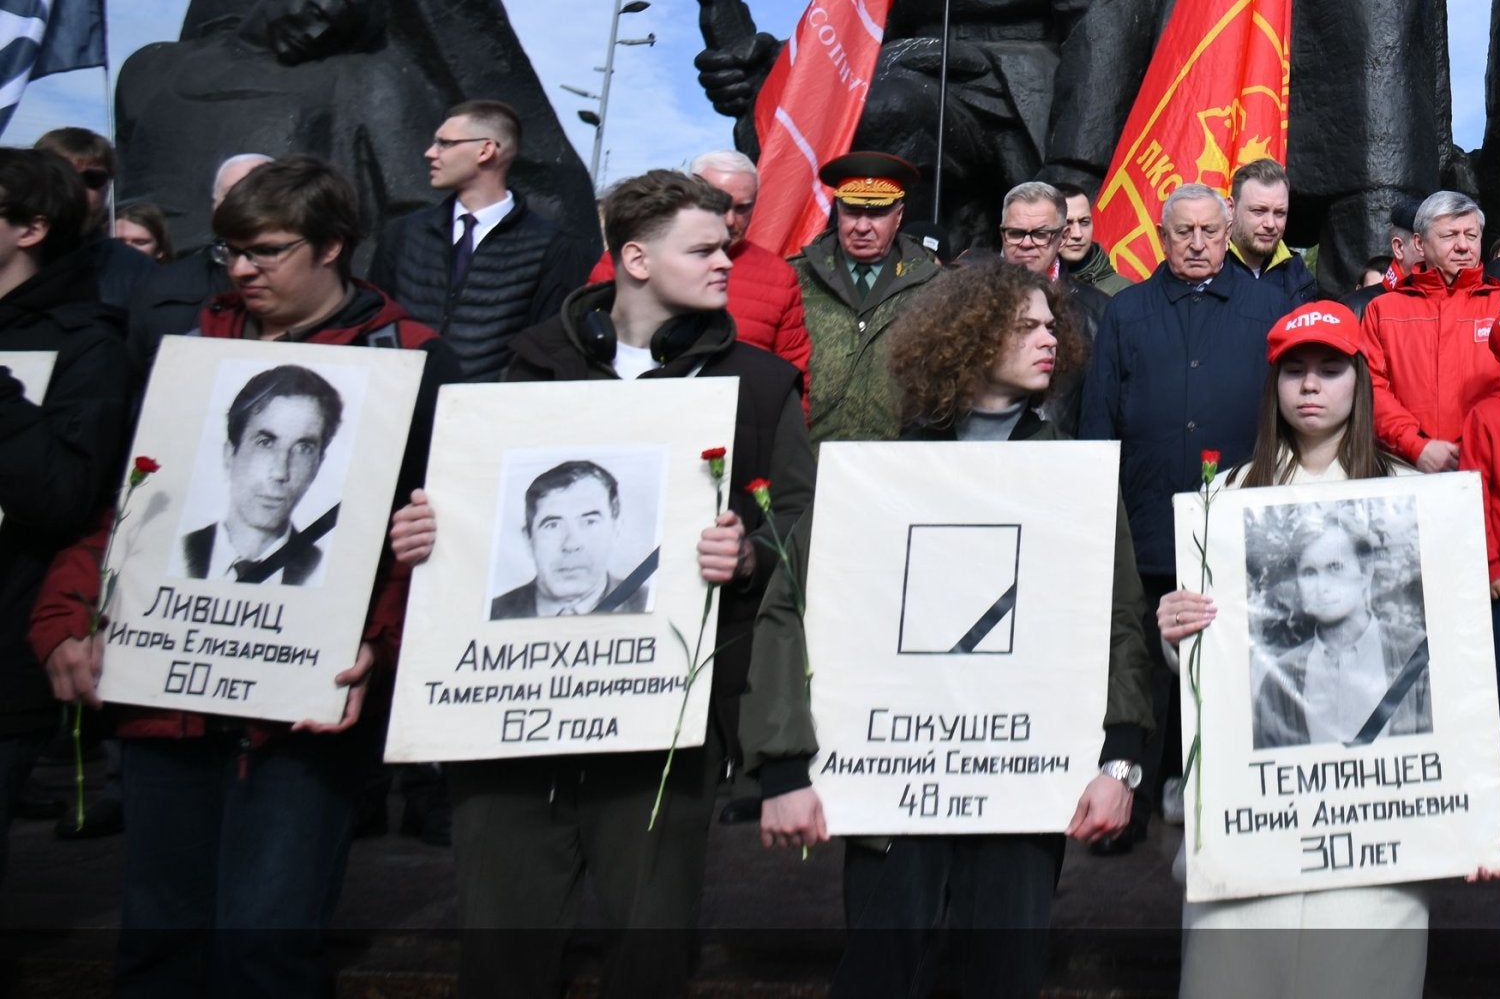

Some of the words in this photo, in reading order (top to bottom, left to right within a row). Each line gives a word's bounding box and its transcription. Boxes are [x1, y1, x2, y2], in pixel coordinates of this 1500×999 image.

[1136, 139, 1184, 201] ЛКС
[1285, 311, 1341, 331] КПРФ
[143, 585, 285, 634] ЛИВШИЦ
[107, 622, 176, 650] ИГОРЬ
[183, 629, 319, 666] ЕЛИЗАРОВИЧ
[455, 637, 656, 672] АМИРХАНОВ
[164, 660, 212, 696] 60
[212, 678, 257, 700] ЛЕТ
[425, 682, 542, 704] ТАМЕРЛАН
[549, 675, 688, 699] ШАРИФОВИЧ
[501, 708, 552, 742] 62
[558, 717, 618, 741] ГОДА
[867, 709, 1031, 742] СОКУШЕВ
[820, 750, 936, 775] АНАТОЛИЙ
[945, 750, 1069, 775] СЕМЕНОВИЧ
[898, 783, 939, 817] 48
[947, 796, 988, 817] ЛЕТ
[1225, 802, 1298, 835] ЮРИЙ
[1312, 794, 1469, 827] АНАТОЛЬЕВИЧ
[1300, 832, 1353, 873] 30
[1360, 841, 1401, 868] ЛЕТ
